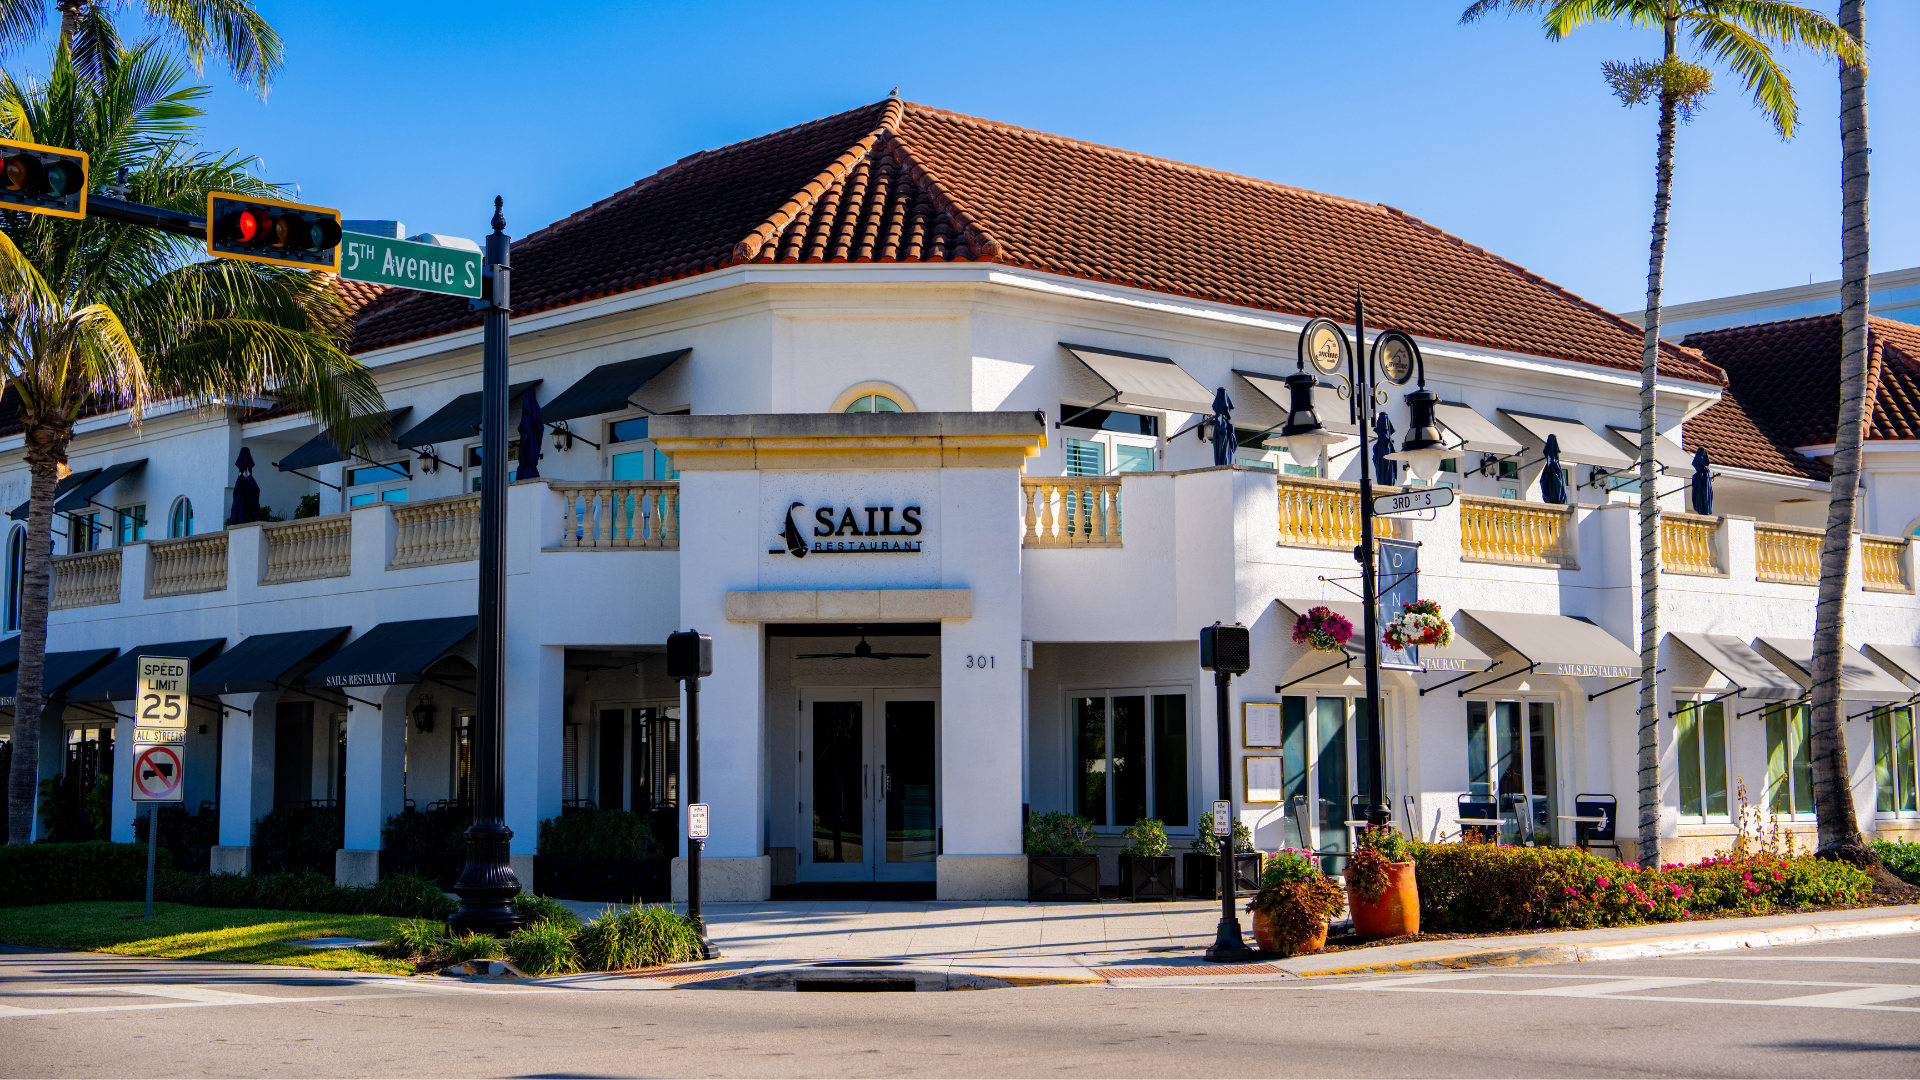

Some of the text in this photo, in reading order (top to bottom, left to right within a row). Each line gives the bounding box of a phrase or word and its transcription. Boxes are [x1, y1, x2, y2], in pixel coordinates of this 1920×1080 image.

[382, 248, 454, 284] Avenue
[464, 261, 475, 288] S
[1392, 493, 1431, 510] 3RD ST S
[814, 506, 922, 537] SAILS
[814, 541, 923, 551] RESTAURANT
[966, 655, 994, 669] 301
[1420, 658, 1466, 670] STAURANT
[144, 664, 184, 677] SPEED
[1558, 664, 1633, 677] SAILS RESTAURANT
[148, 679, 178, 691] LIMIT
[326, 672, 397, 687] SAILS RESTAURANT
[142, 693, 181, 720] 25
[137, 730, 183, 742] ALL STREETS
